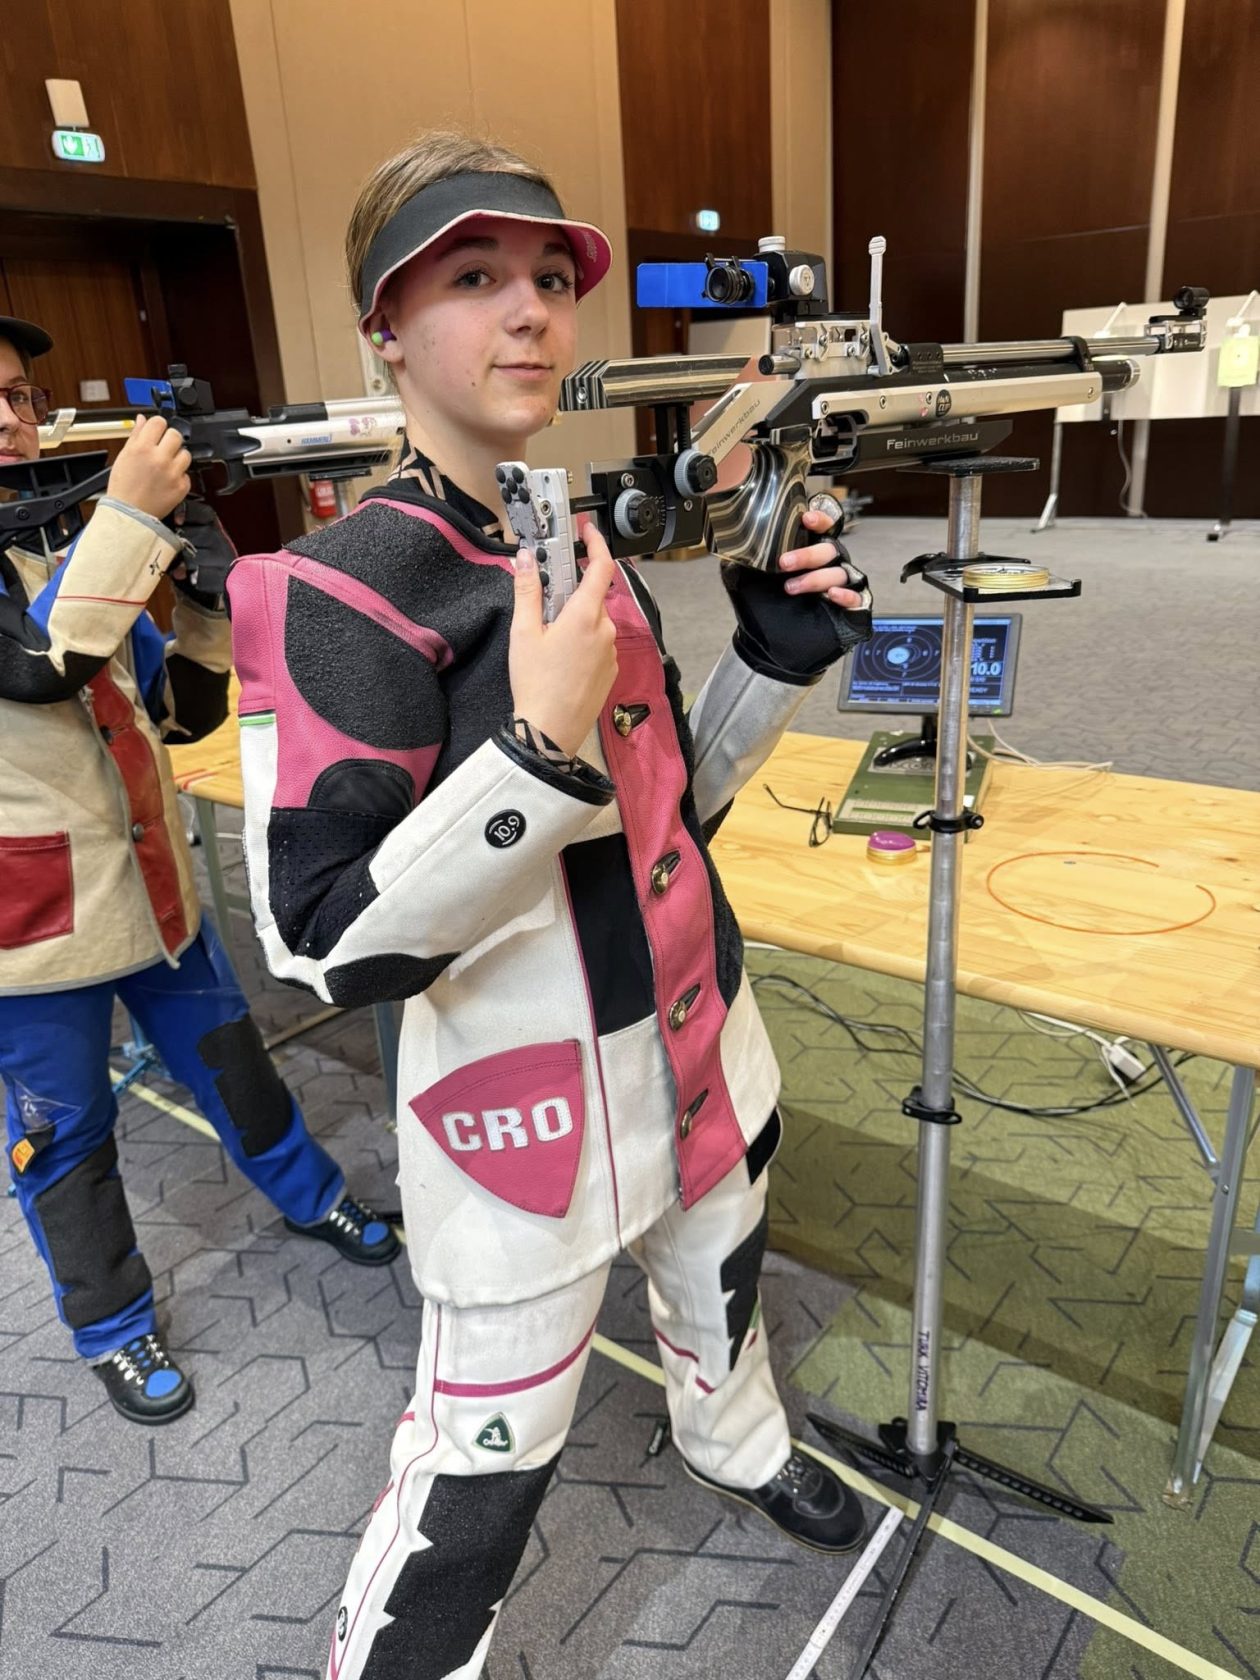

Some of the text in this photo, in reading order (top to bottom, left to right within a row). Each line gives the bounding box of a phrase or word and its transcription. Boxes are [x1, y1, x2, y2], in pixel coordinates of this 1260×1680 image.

[886, 433, 979, 450] Feinwerkbau
[970, 661, 1002, 676] 10.0
[494, 815, 520, 841] 10.9
[442, 1096, 574, 1151] CRO
